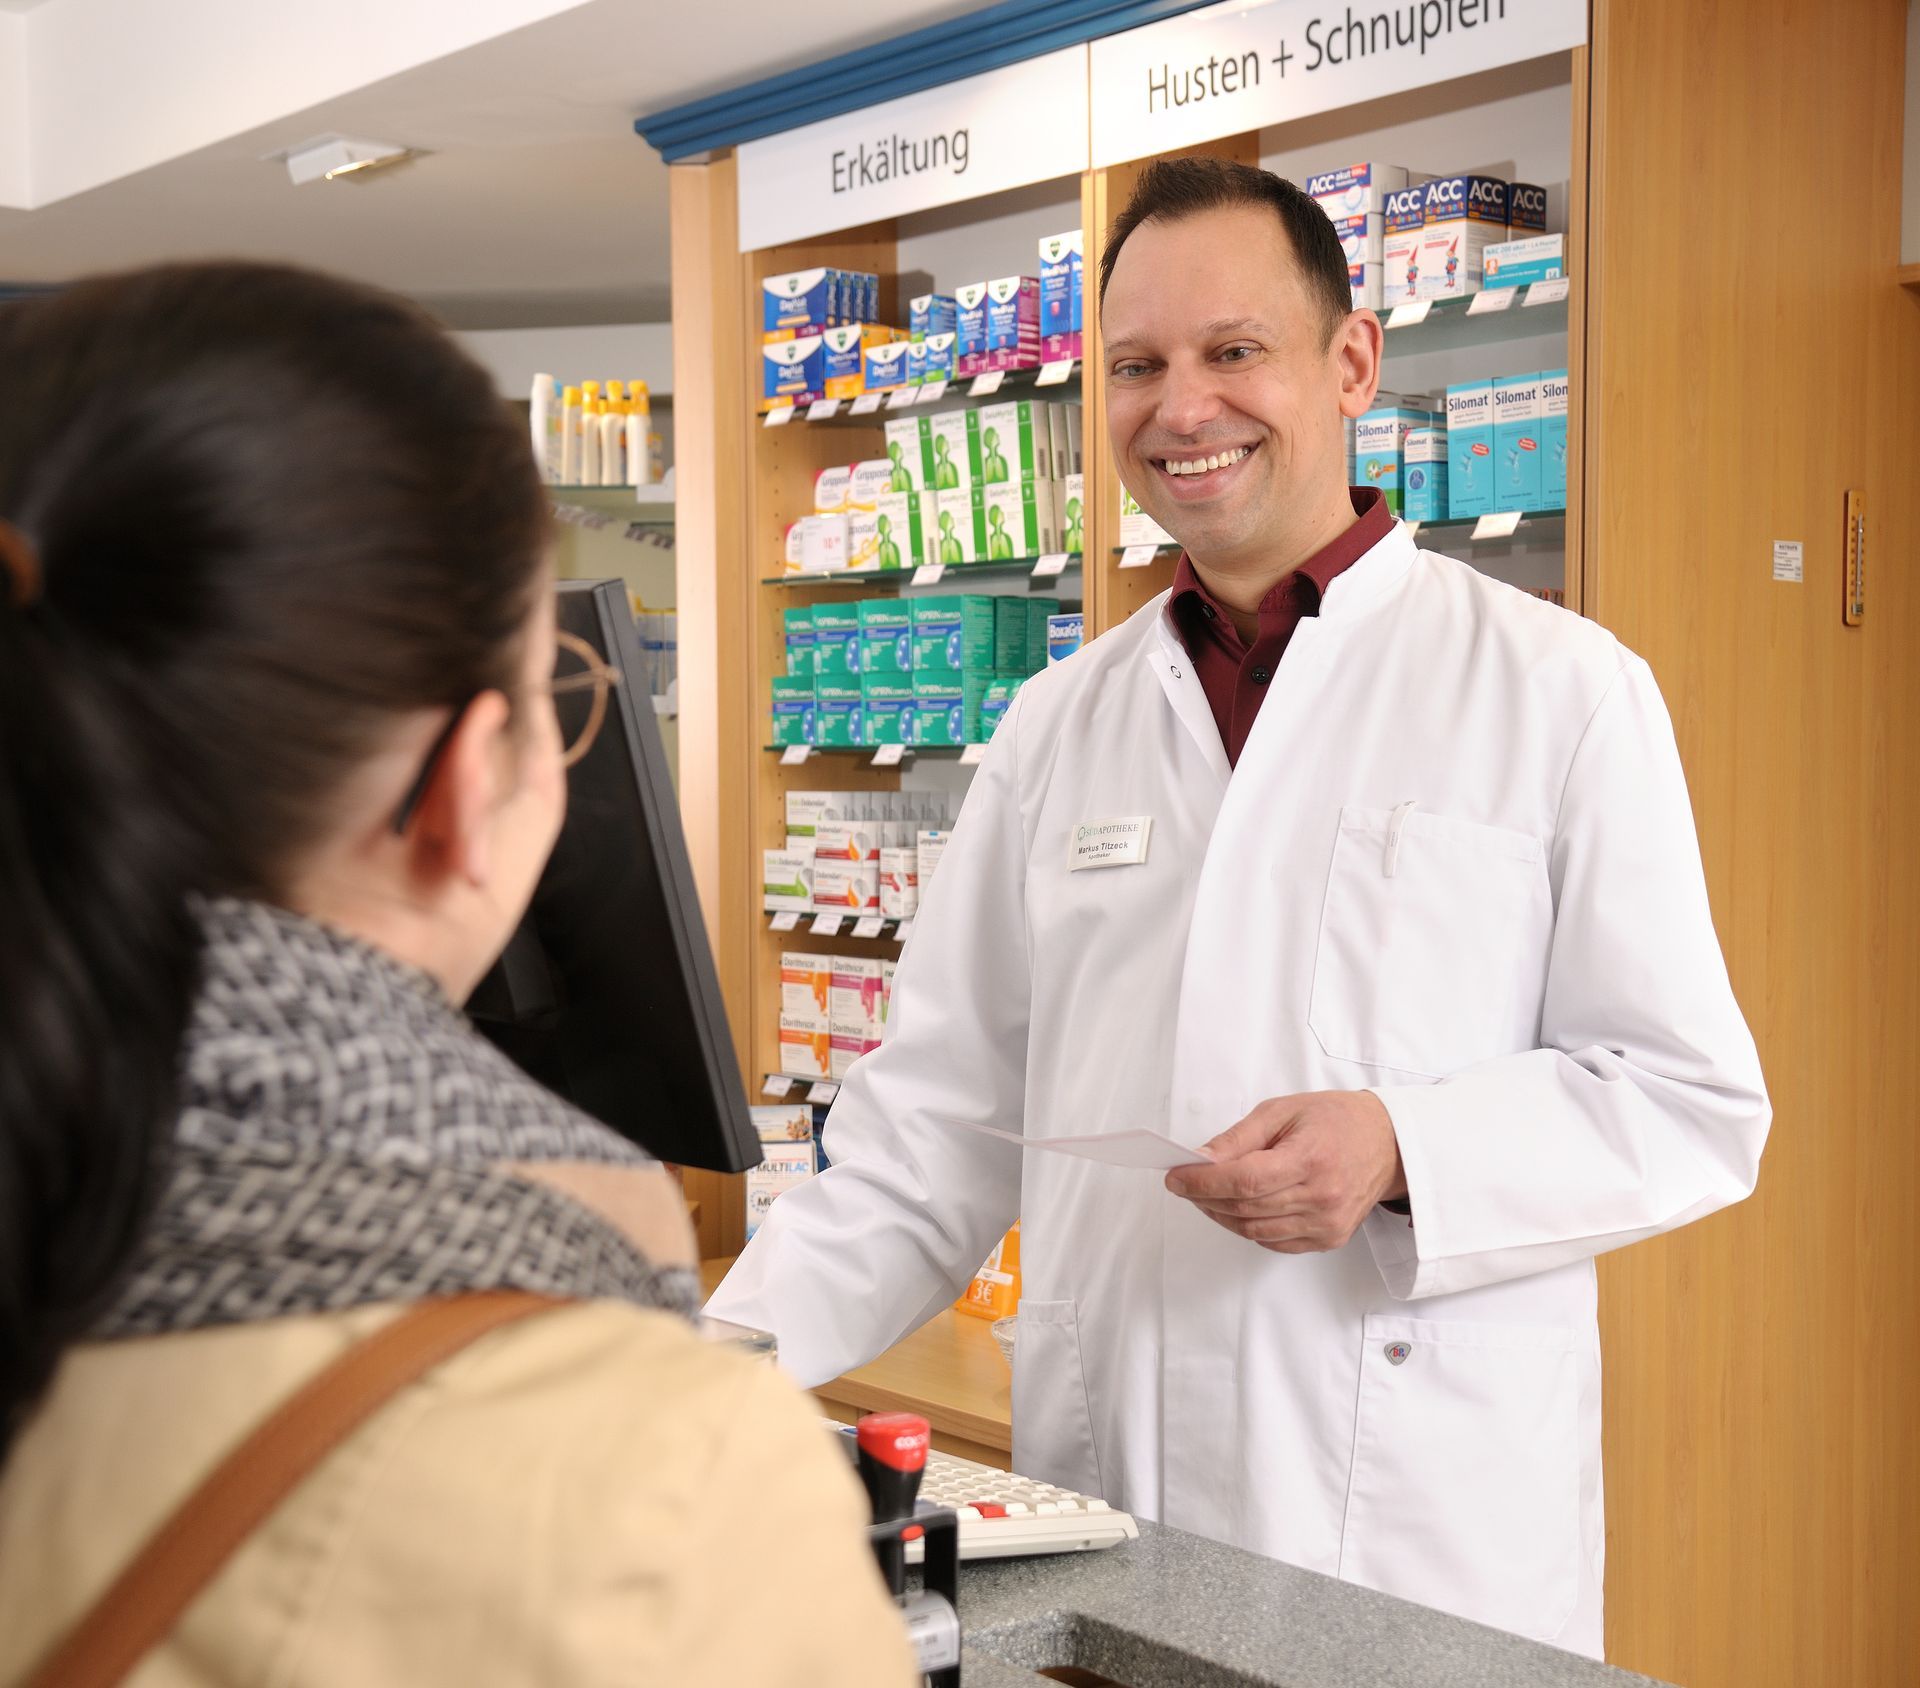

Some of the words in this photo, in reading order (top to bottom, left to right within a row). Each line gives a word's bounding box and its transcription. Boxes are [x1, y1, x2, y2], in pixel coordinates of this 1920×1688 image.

[1148, 51, 1260, 114] Husten
[1271, 39, 1294, 78] +
[832, 128, 969, 194] Erkältung
[1309, 174, 1335, 194] ACC
[1425, 179, 1464, 206] ACC
[1468, 180, 1503, 203] ACC
[1385, 189, 1421, 217] ACC
[1512, 188, 1544, 211] ACC
[1449, 394, 1488, 411] Silomat
[1496, 388, 1537, 405] Silomat
[1357, 423, 1394, 438] Silomat
[1406, 438, 1427, 447] Silomat
[1078, 844, 1099, 855] Markus
[1101, 841, 1128, 851] Titzeck
[757, 1161, 809, 1174] MULTILAC
